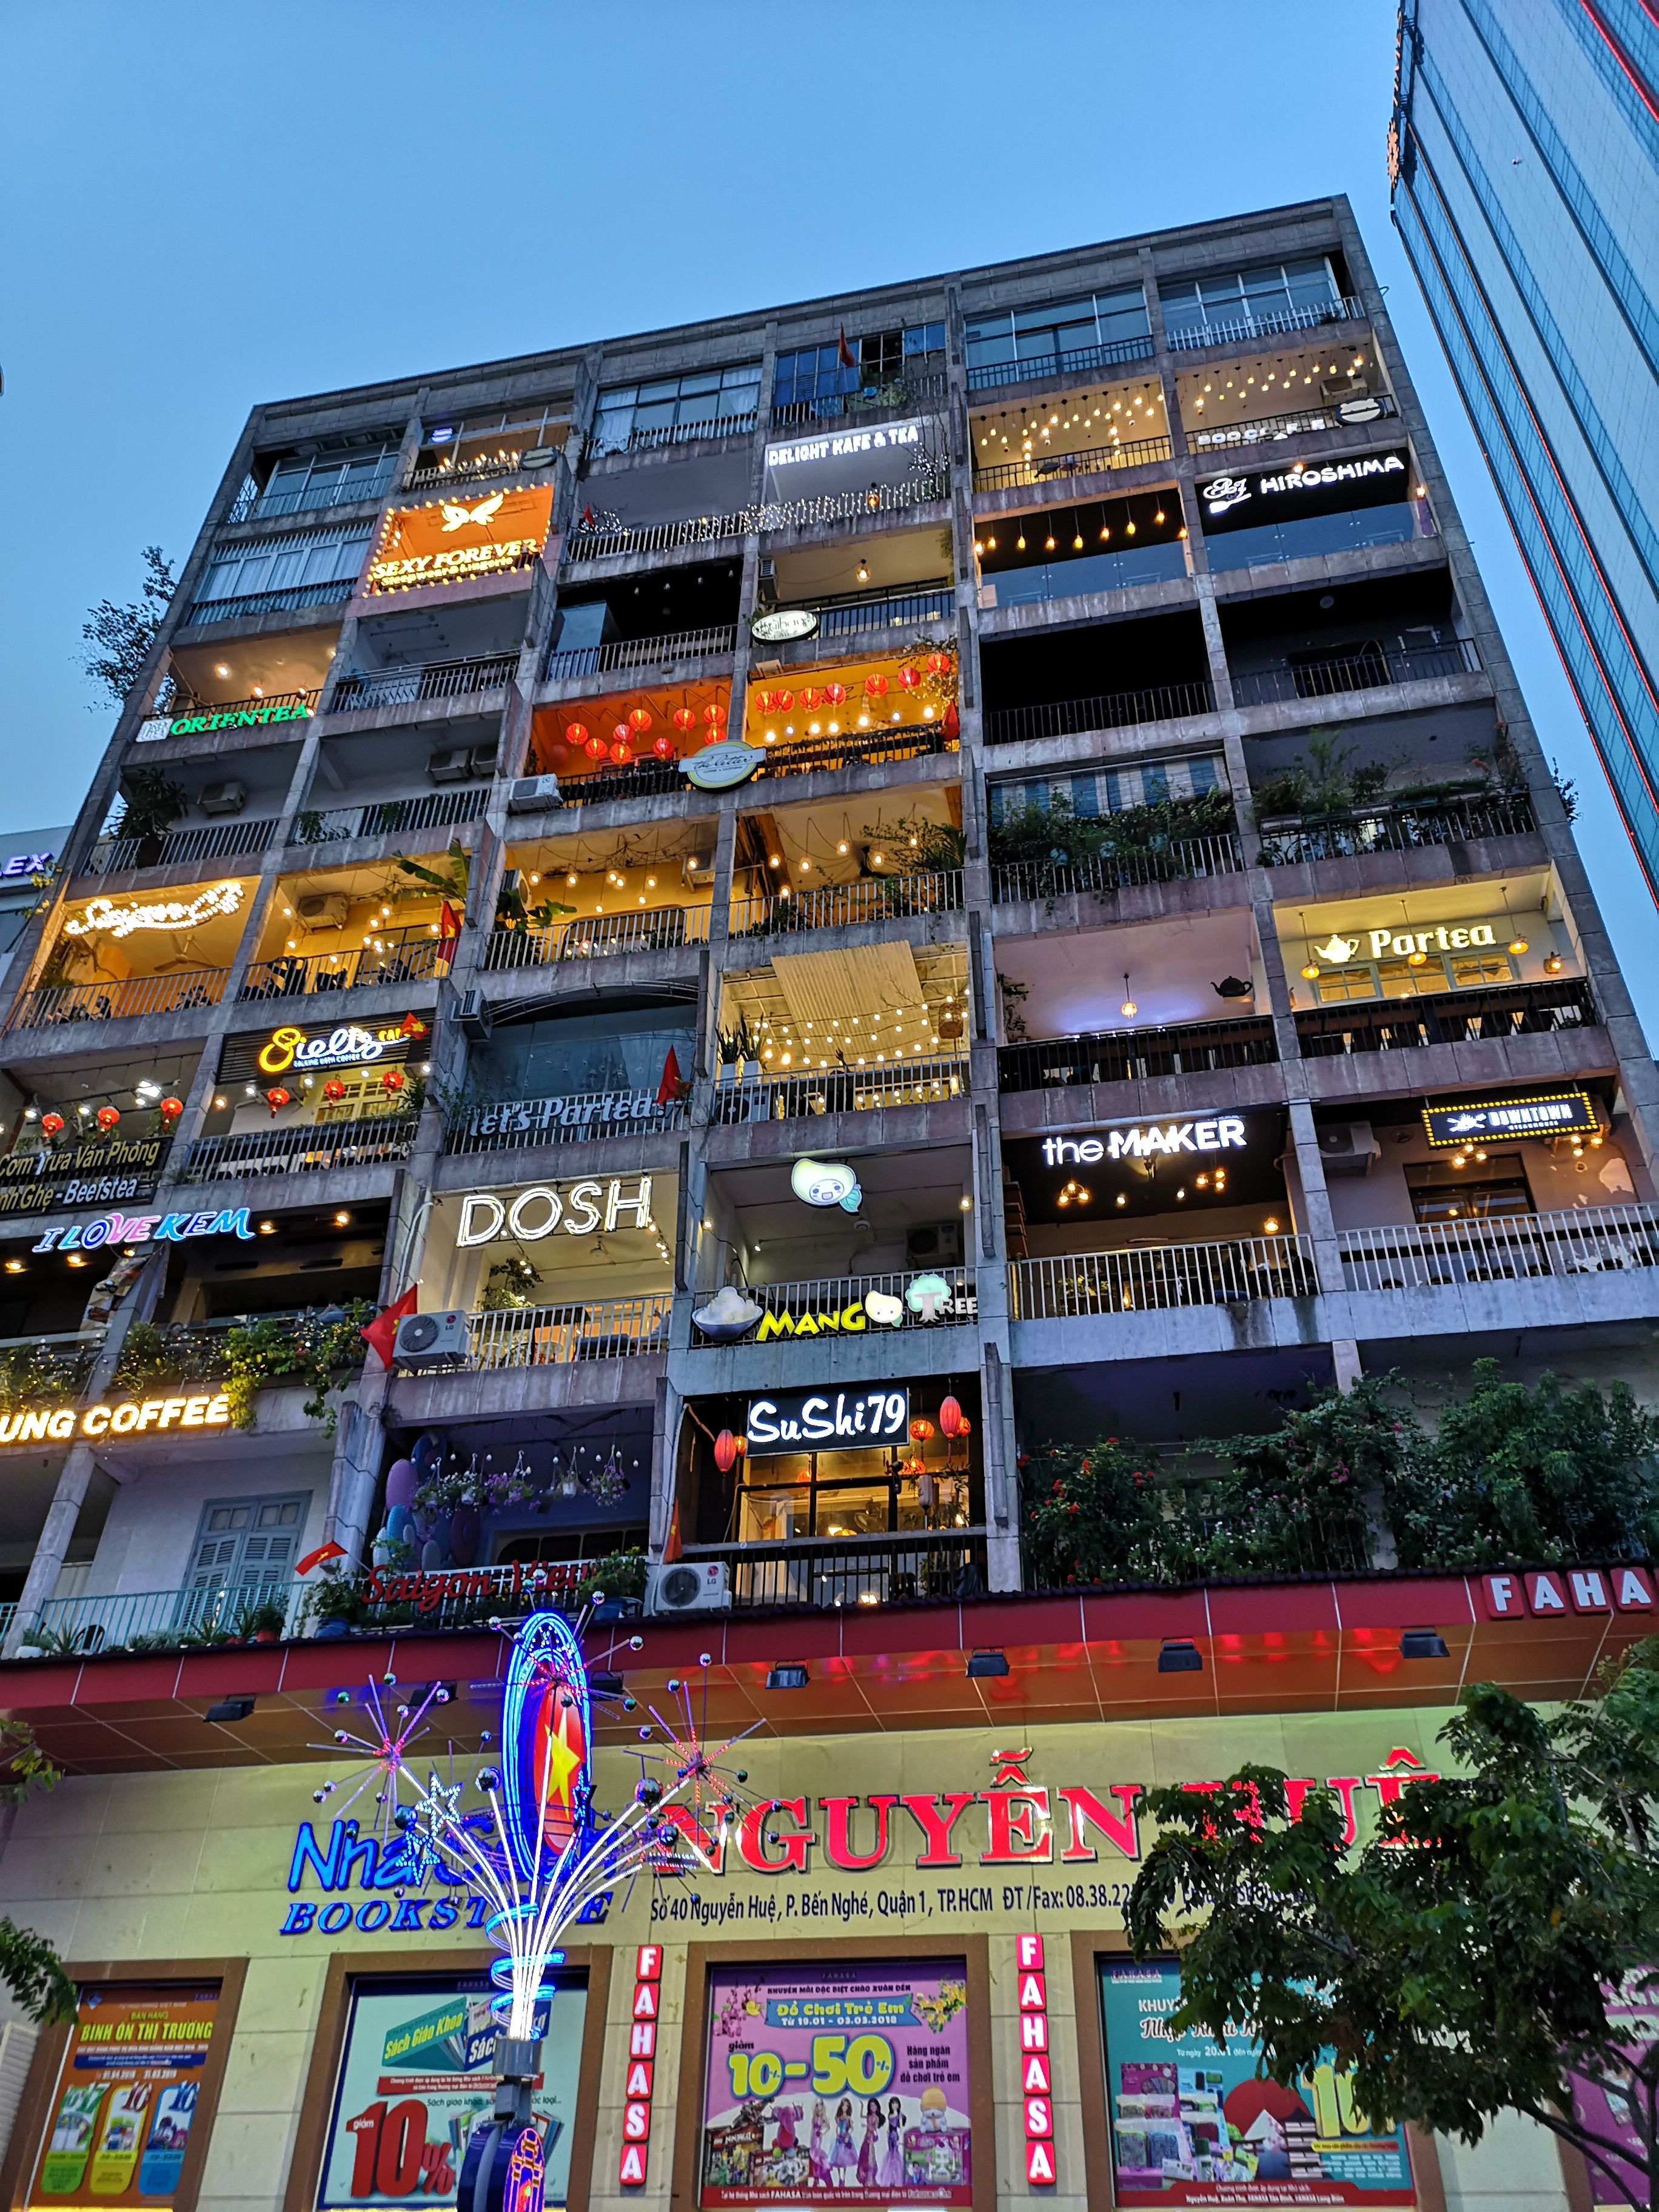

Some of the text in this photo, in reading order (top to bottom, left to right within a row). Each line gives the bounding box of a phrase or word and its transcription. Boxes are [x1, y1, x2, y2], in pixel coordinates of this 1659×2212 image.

[768, 425, 919, 466] DELIGHT KAFE & TEA
[1260, 457, 1404, 494] HIROSHIMA
[373, 538, 538, 578] SEXY FOREVER
[170, 703, 310, 736] ORIENTEA
[0, 851, 53, 876] EX
[1369, 925, 1496, 959] Partea
[75, 1143, 106, 1170] Văn
[106, 1140, 161, 1167] Phòng
[1042, 1116, 1247, 1166] the MAKER
[20, 1184, 54, 1213] Ghẹ
[456, 1176, 653, 1248] DOSH
[32, 1206, 256, 1253] I LOVE KEM
[0, 1393, 230, 1443] UNG COFFEE
[361, 1564, 497, 1611] Saigon
[1490, 1570, 1651, 1612] FAHA
[655, 1746, 1144, 1877] NGUYỄN
[280, 1891, 614, 1936] BOOKSTE
[651, 1895, 670, 1922] Số
[670, 1897, 688, 1921] 40
[690, 1892, 744, 1926] Nguyễn
[748, 1894, 783, 1923] Huệ,
[786, 1893, 799, 1917] P.
[802, 1890, 823, 1917] Bến
[831, 1890, 873, 1923] Nghé,
[877, 1889, 915, 1919] Quận
[919, 1889, 933, 1917] 1,
[937, 1887, 993, 1913] TP.HCM
[1066, 1883, 1133, 1909] 08.38.22
[798, 2017, 825, 2026] 19.01
[837, 2016, 897, 2025] 03.03.2018
[803, 2003, 841, 2016] Chơi
[878, 2002, 904, 2014] Em
[80, 2022, 114, 2042] BÌNH
[136, 2022, 159, 2043] THỊ
[161, 2019, 214, 2040] TRƯỜNG
[384, 2033, 411, 2060] Sách
[412, 2025, 435, 2047] Giáo
[435, 2012, 463, 2037] Khoa
[468, 2036, 496, 2063] Sác
[621, 1947, 657, 2180] FAHASA
[1021, 1937, 1054, 2179] FAHASA
[427, 2098, 445, 2106] Sách
[446, 2098, 463, 2108] giáo
[346, 2099, 455, 2198] 10%
